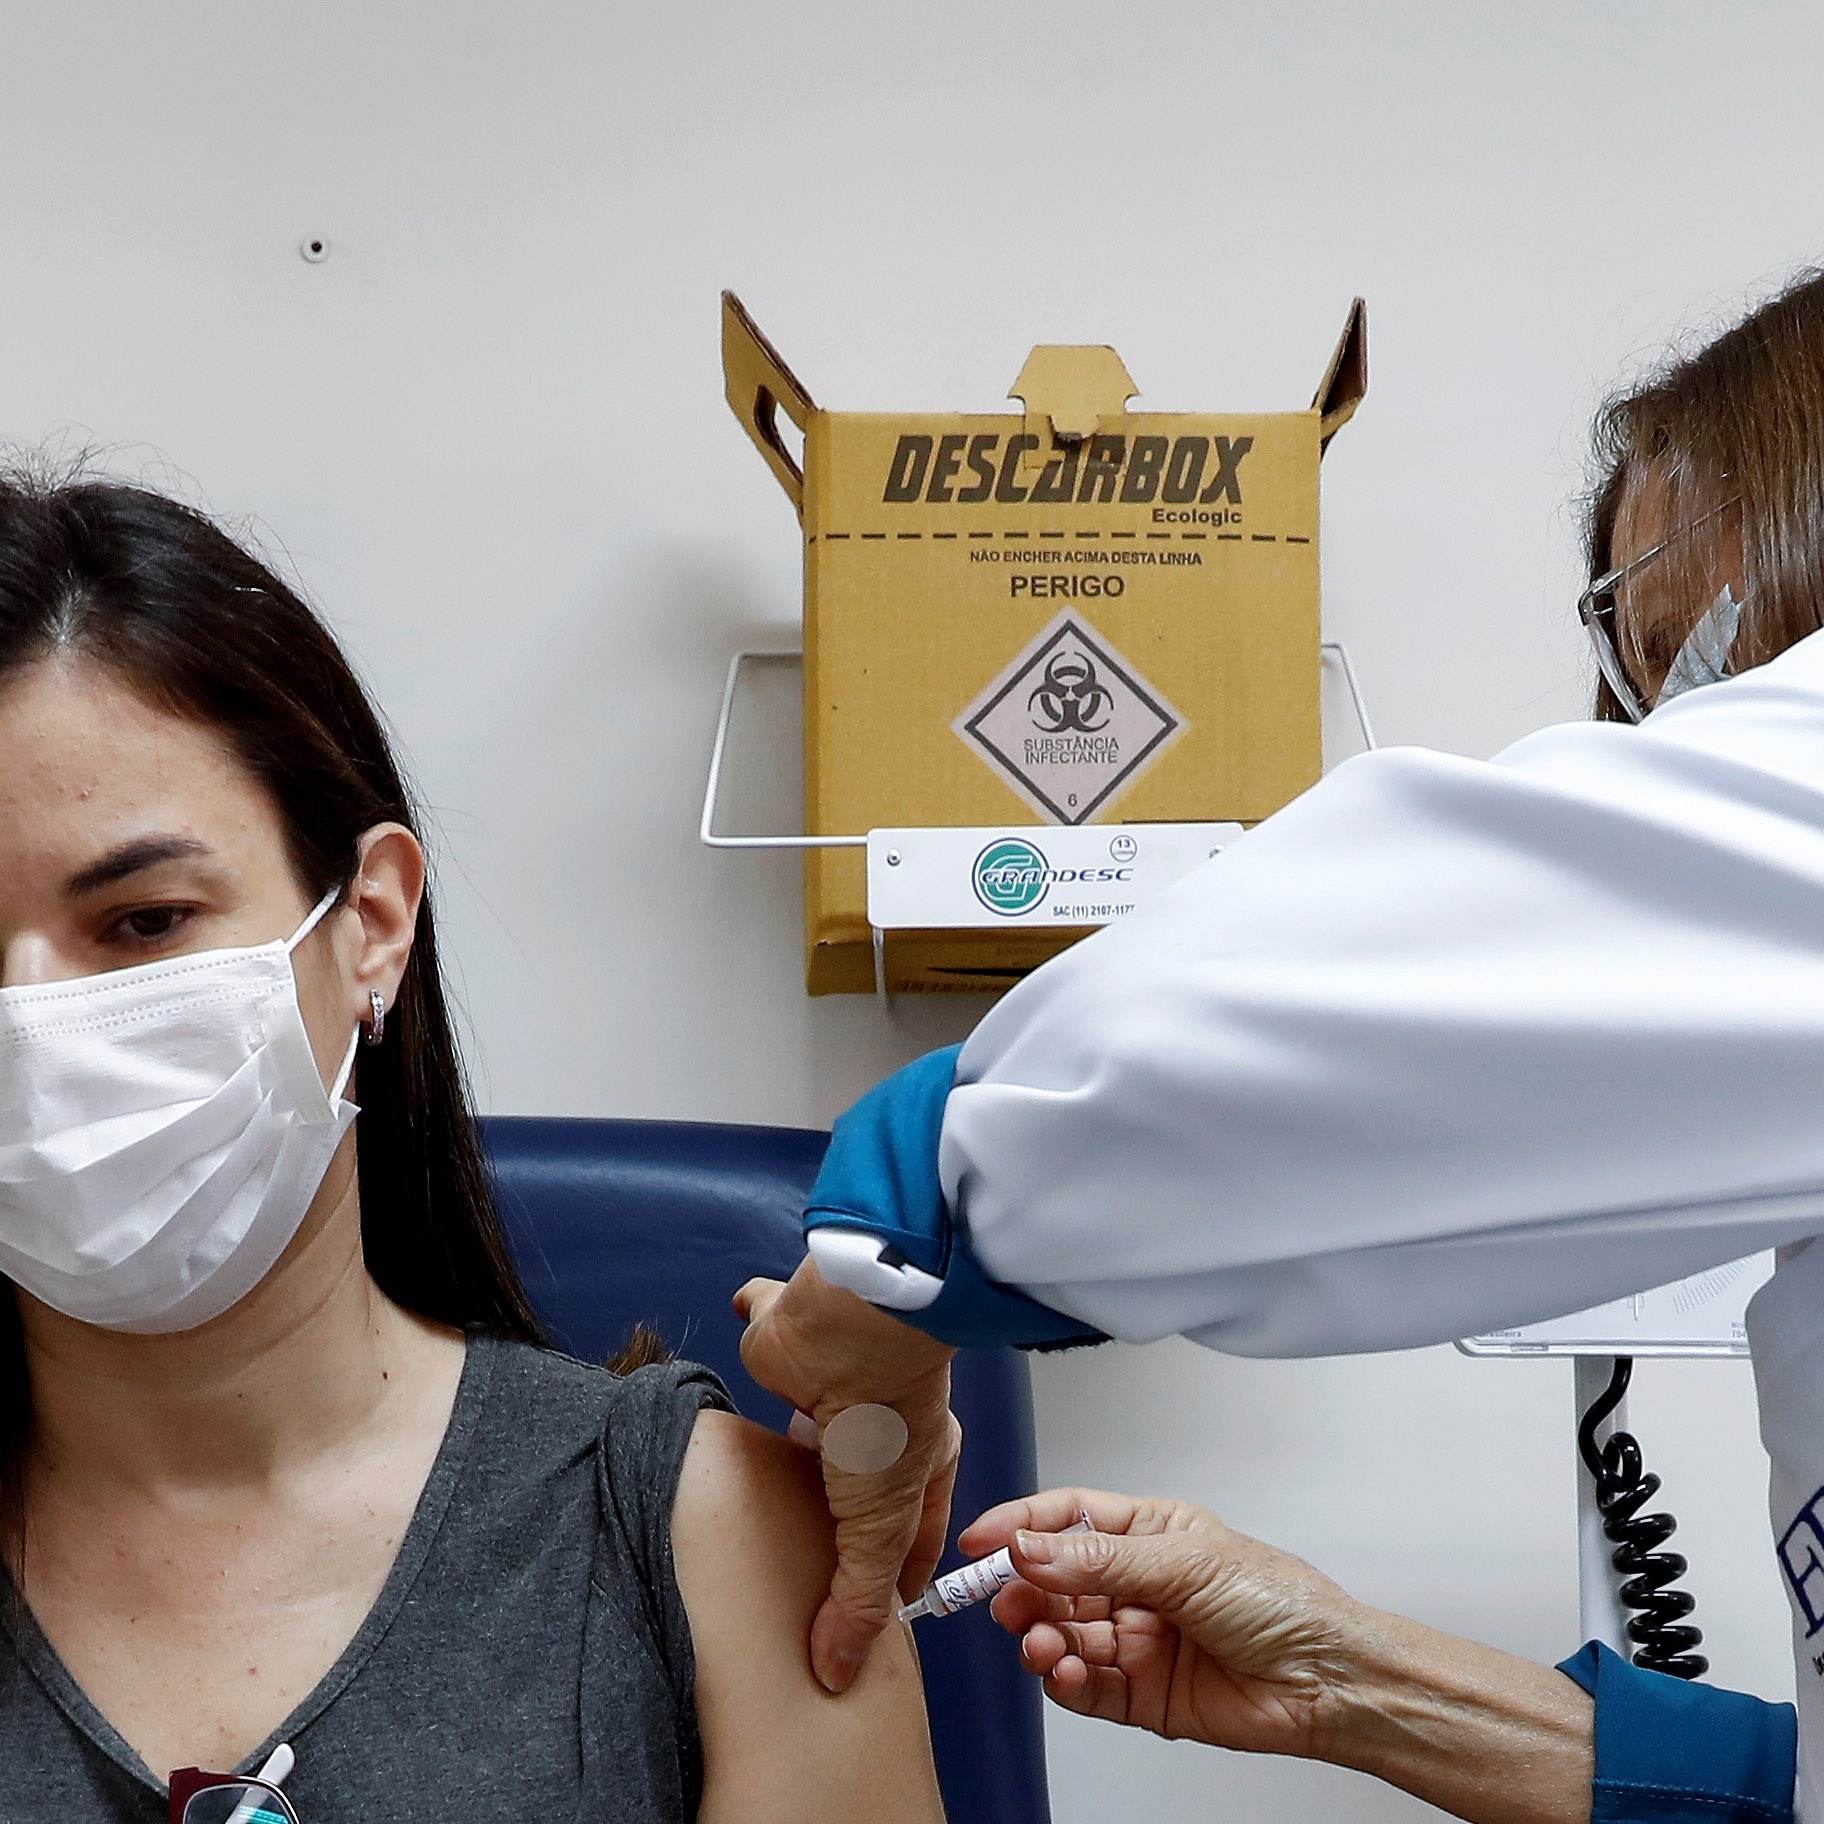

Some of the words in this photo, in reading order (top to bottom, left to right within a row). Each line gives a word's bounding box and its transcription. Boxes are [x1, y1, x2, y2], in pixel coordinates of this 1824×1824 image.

[881, 433, 1254, 504] DESCARBOX
[1152, 508, 1243, 527] Ecologic
[970, 549, 1000, 563] NÃO
[1004, 551, 1062, 563] ENCHER
[1064, 551, 1109, 564] ACIMA
[1111, 551, 1157, 565] DESTA
[1160, 552, 1202, 566] LINHA
[1010, 575, 1126, 598] PERIGO
[1024, 736, 1120, 751] SUBSTÂNCIA
[1025, 751, 1118, 764] INFECTANTE
[1067, 793, 1078, 807] 6
[1116, 839, 1131, 849] 13
[982, 867, 1134, 885] GRANDESC
[1053, 904, 1070, 917] SAC
[1072, 904, 1089, 919] (11)
